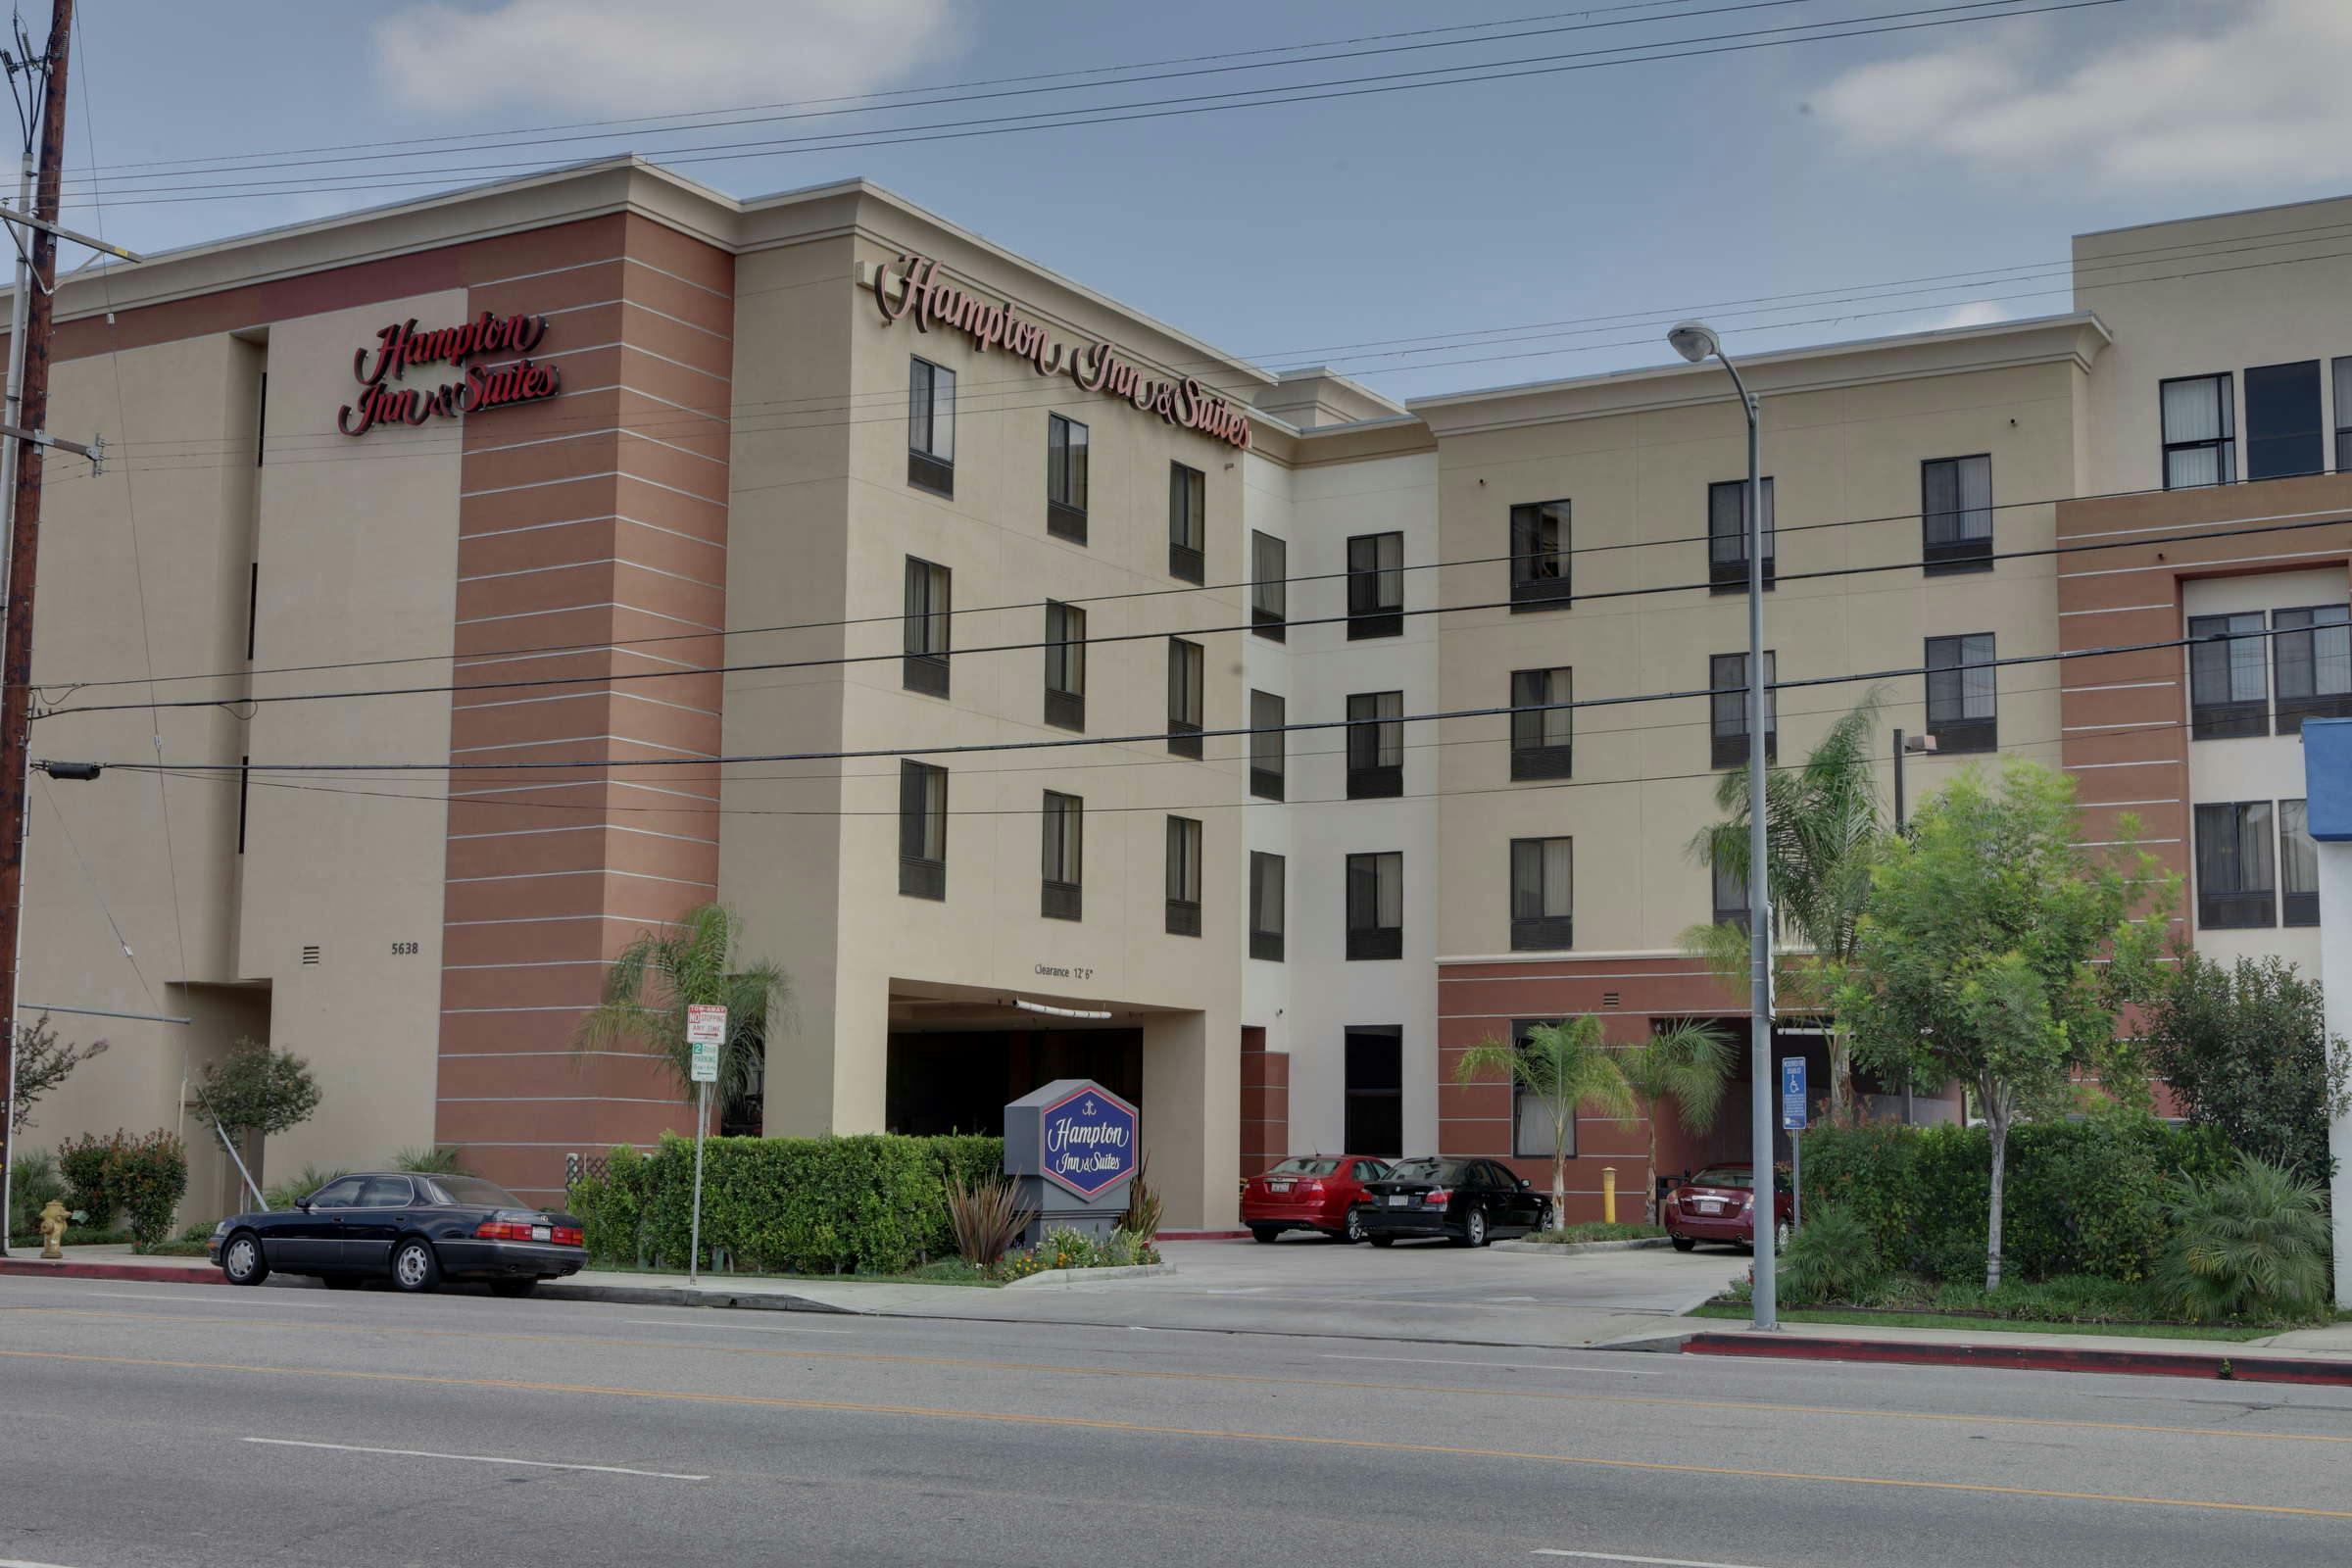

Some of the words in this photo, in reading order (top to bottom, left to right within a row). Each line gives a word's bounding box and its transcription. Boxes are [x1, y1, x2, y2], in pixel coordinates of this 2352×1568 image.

[354, 311, 546, 385] Hampton
[875, 254, 1064, 376] Hampton
[1071, 341, 1157, 411] Inn
[1155, 382, 1176, 425] &
[1174, 377, 1252, 450] Suites
[338, 382, 432, 437] Inn
[429, 384, 458, 418] &
[453, 359, 561, 413] Suites
[391, 942, 418, 955] 5638
[1034, 963, 1070, 978] Clearance
[689, 1012, 700, 1023] NO
[694, 1043, 703, 1054] 2
[1048, 1117, 1129, 1152] Hampton
[1055, 1152, 1083, 1174] Inn
[1083, 1159, 1092, 1173] &
[1089, 1152, 1120, 1171] Suites
